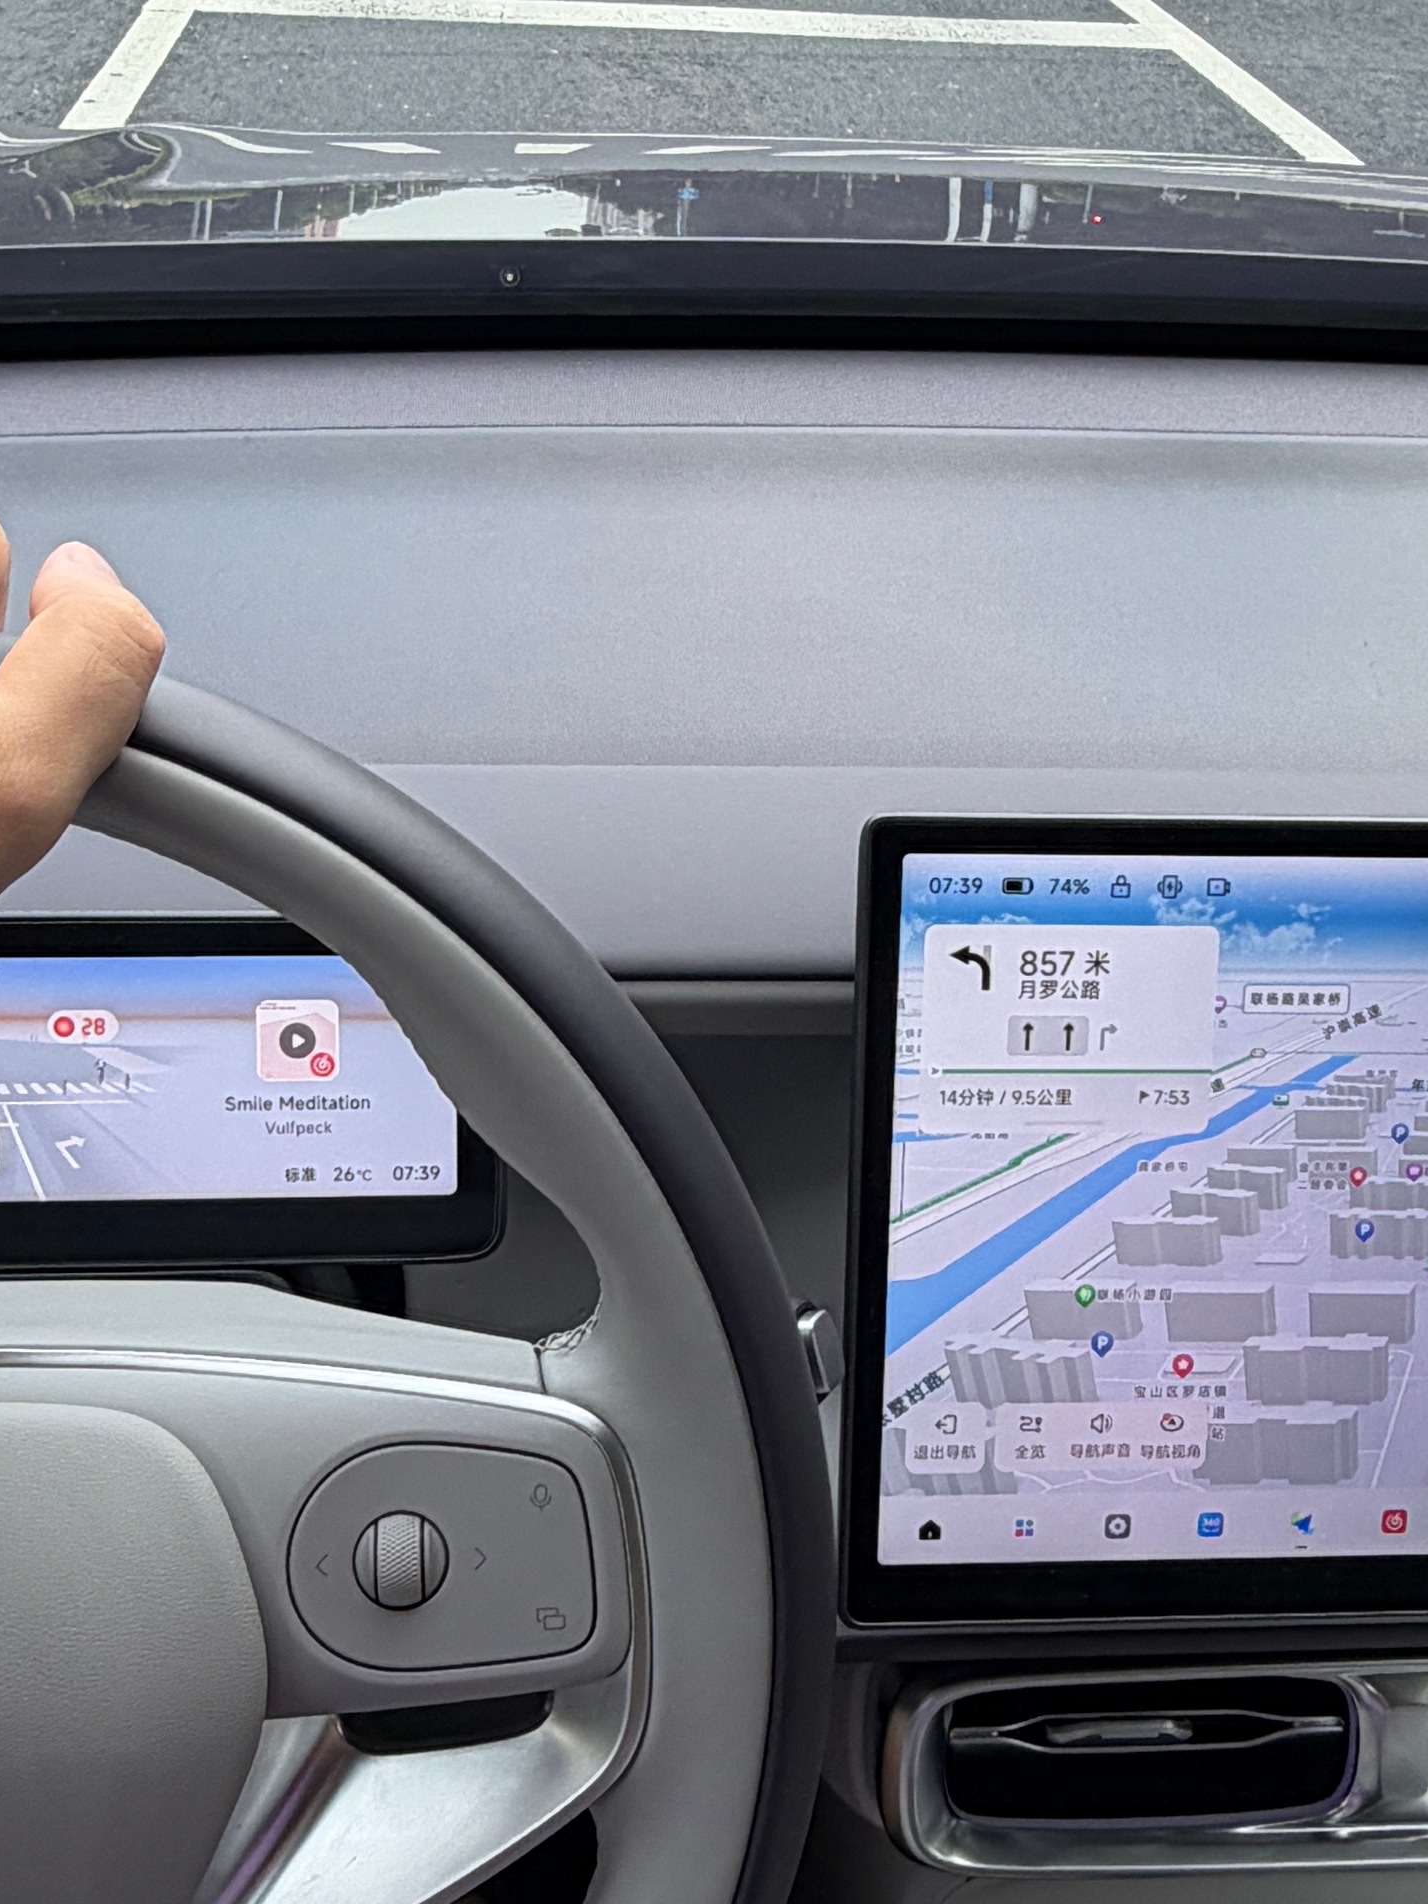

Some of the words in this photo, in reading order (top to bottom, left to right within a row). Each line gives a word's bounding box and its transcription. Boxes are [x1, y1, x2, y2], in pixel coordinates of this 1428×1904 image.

[929, 877, 983, 894] 07:39
[1049, 878, 1090, 894] 74%
[1020, 951, 1076, 976] 857
[1084, 950, 1111, 976] 米
[1018, 980, 1100, 1000] 月罗公路
[81, 1017, 106, 1035] 28
[225, 1095, 273, 1112] Smile
[279, 1094, 371, 1111] Meditation
[940, 1089, 994, 1108] 14分钟
[1011, 1089, 1073, 1107] 9.5公里
[1153, 1089, 1191, 1106] 7:53
[265, 1120, 333, 1137] Vulfpeck
[285, 1166, 316, 1183] 标准
[392, 1165, 441, 1181] 07:39
[913, 1444, 977, 1460] 退出导航
[1014, 1444, 1047, 1460] 全览
[1070, 1443, 1131, 1459] 导航声音
[1139, 1444, 1201, 1460] 导航视角
